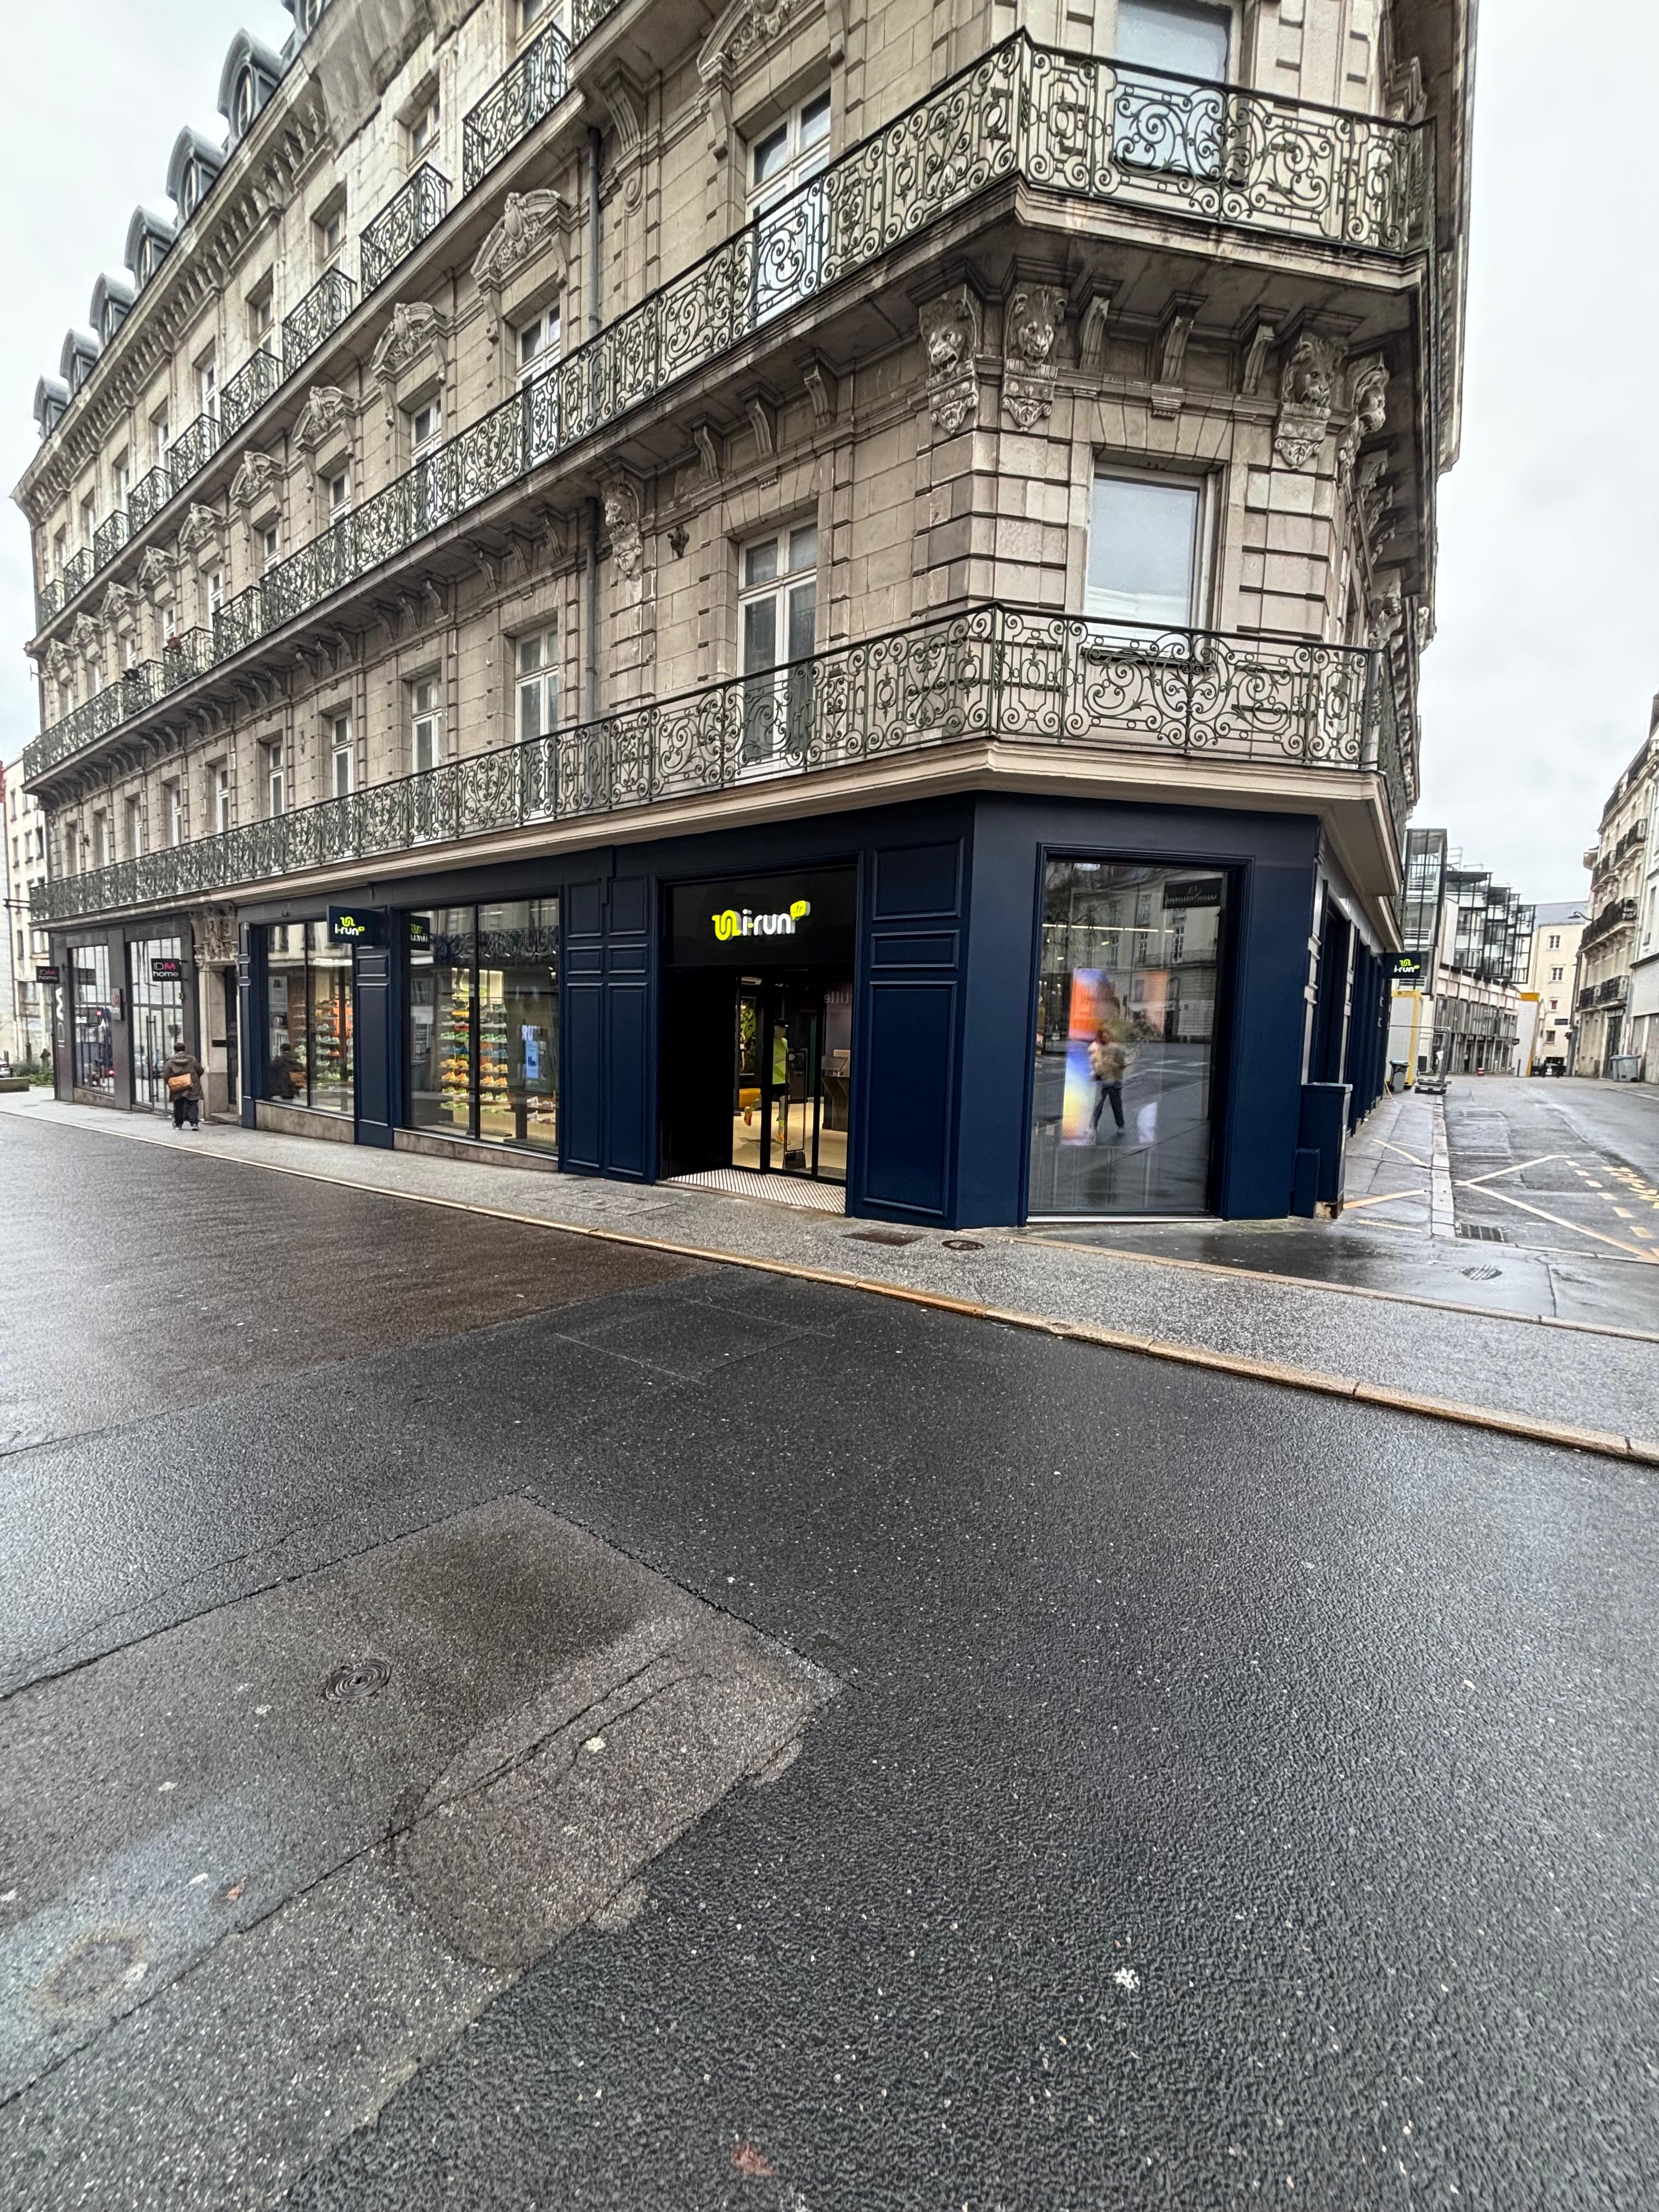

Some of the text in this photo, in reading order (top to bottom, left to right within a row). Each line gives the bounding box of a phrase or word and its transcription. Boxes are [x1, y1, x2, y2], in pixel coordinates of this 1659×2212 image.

[742, 909, 793, 936] i-run
[335, 923, 359, 936] i-run
[1393, 964, 1415, 973] i-run
